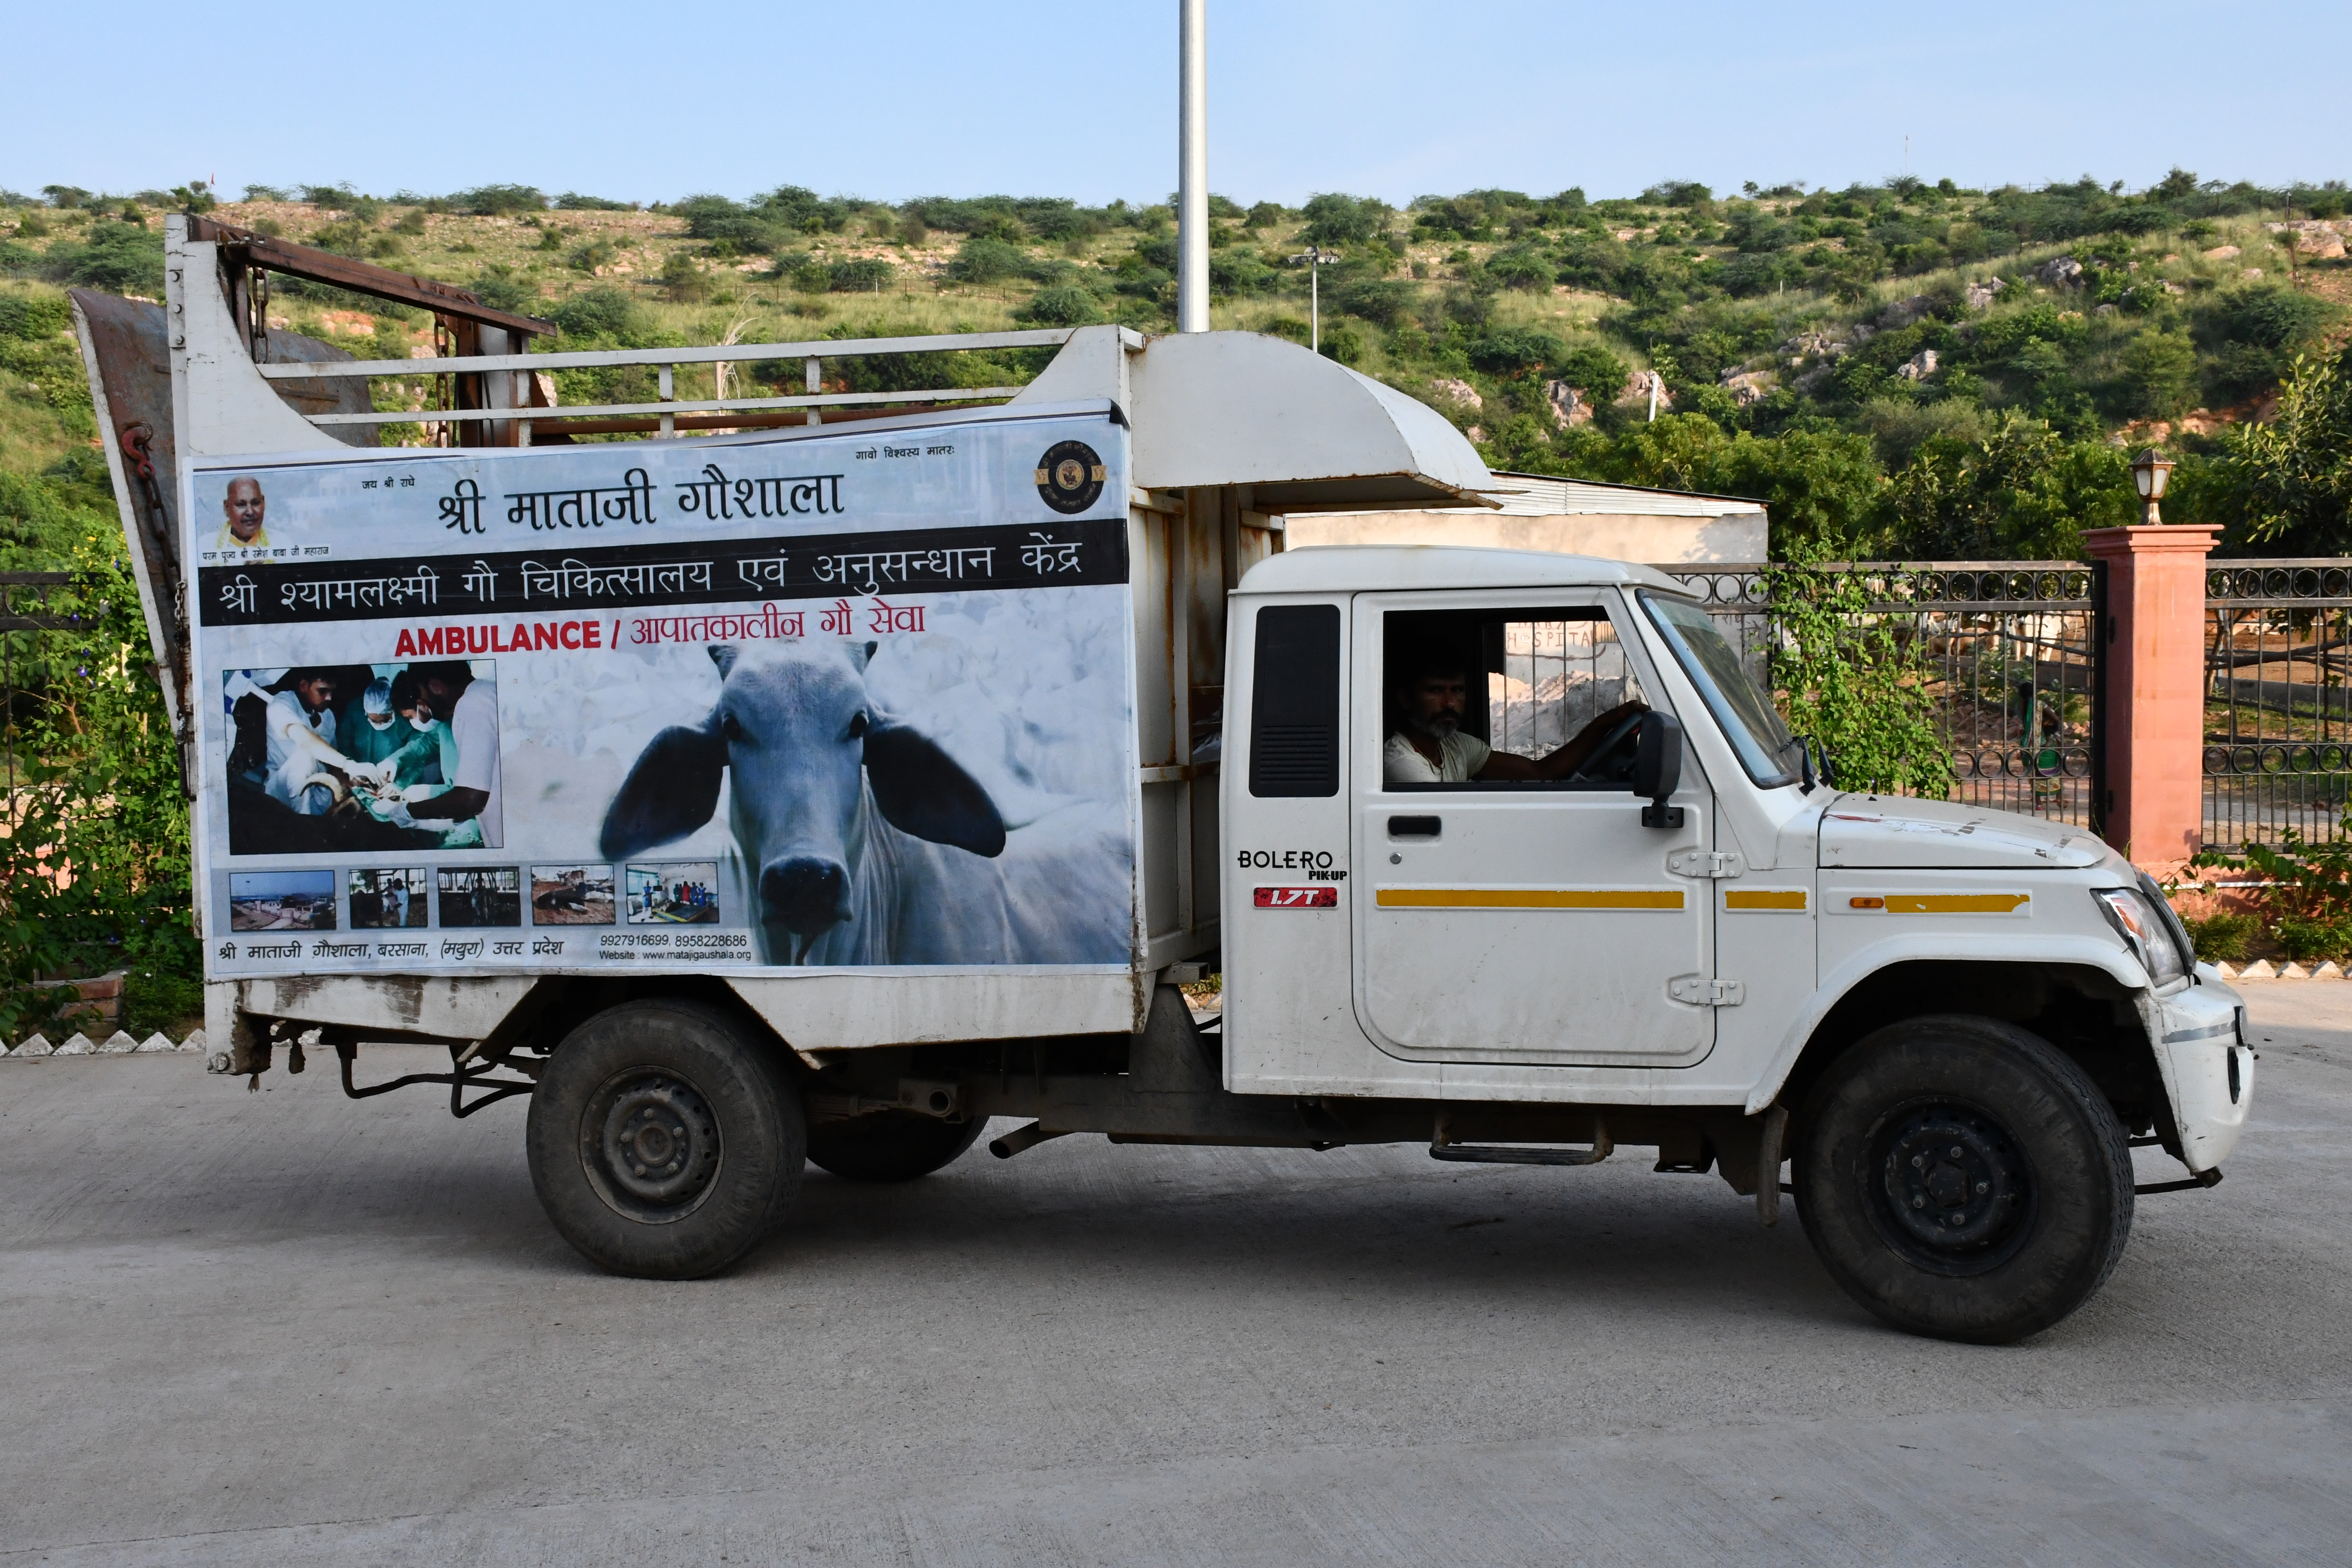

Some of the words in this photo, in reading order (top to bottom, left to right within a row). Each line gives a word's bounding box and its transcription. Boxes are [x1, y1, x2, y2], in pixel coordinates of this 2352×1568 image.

[856, 447, 877, 460] गावो
[884, 446, 920, 458] विश्वस्य
[927, 446, 955, 455] मातरः
[362, 481, 378, 489] जय
[384, 476, 394, 488] श्री
[438, 479, 486, 534] श्री
[504, 468, 657, 530] माताजी
[675, 464, 844, 520] गौशाला
[202, 552, 217, 560] परम
[221, 551, 235, 563] पूज्य
[253, 547, 268, 558] रमेश
[291, 545, 299, 556] जी
[304, 547, 329, 557] महाराज
[219, 574, 258, 613] श्री
[281, 565, 440, 611] श्यामलक्ष्मी
[462, 560, 498, 602] गौ
[520, 558, 714, 600] चिकित्सालय
[737, 548, 789, 591] एवं
[812, 547, 996, 596] अनुसन्धान
[1020, 532, 1083, 575] केंद्र
[630, 602, 805, 644] आपातकालीन
[819, 599, 852, 635] गौ
[868, 597, 926, 633] सेवा
[395, 621, 601, 656] AMBULANCE
[1237, 851, 1333, 870] BOLERO
[1309, 871, 1347, 880] PIK-UP
[1270, 890, 1319, 905] 1.7T
[219, 942, 237, 959] श्री
[247, 940, 302, 958] माताजी
[312, 939, 371, 959] गौशाला,
[378, 943, 428, 958] बरसाना,
[493, 942, 524, 955] उत्तर
[533, 936, 564, 955] प्रदेश
[600, 934, 671, 947] 9927916699,
[675, 935, 747, 947] 8958228686
[599, 950, 635, 960] Website
[642, 950, 751, 961] www.matajigaushala.org
